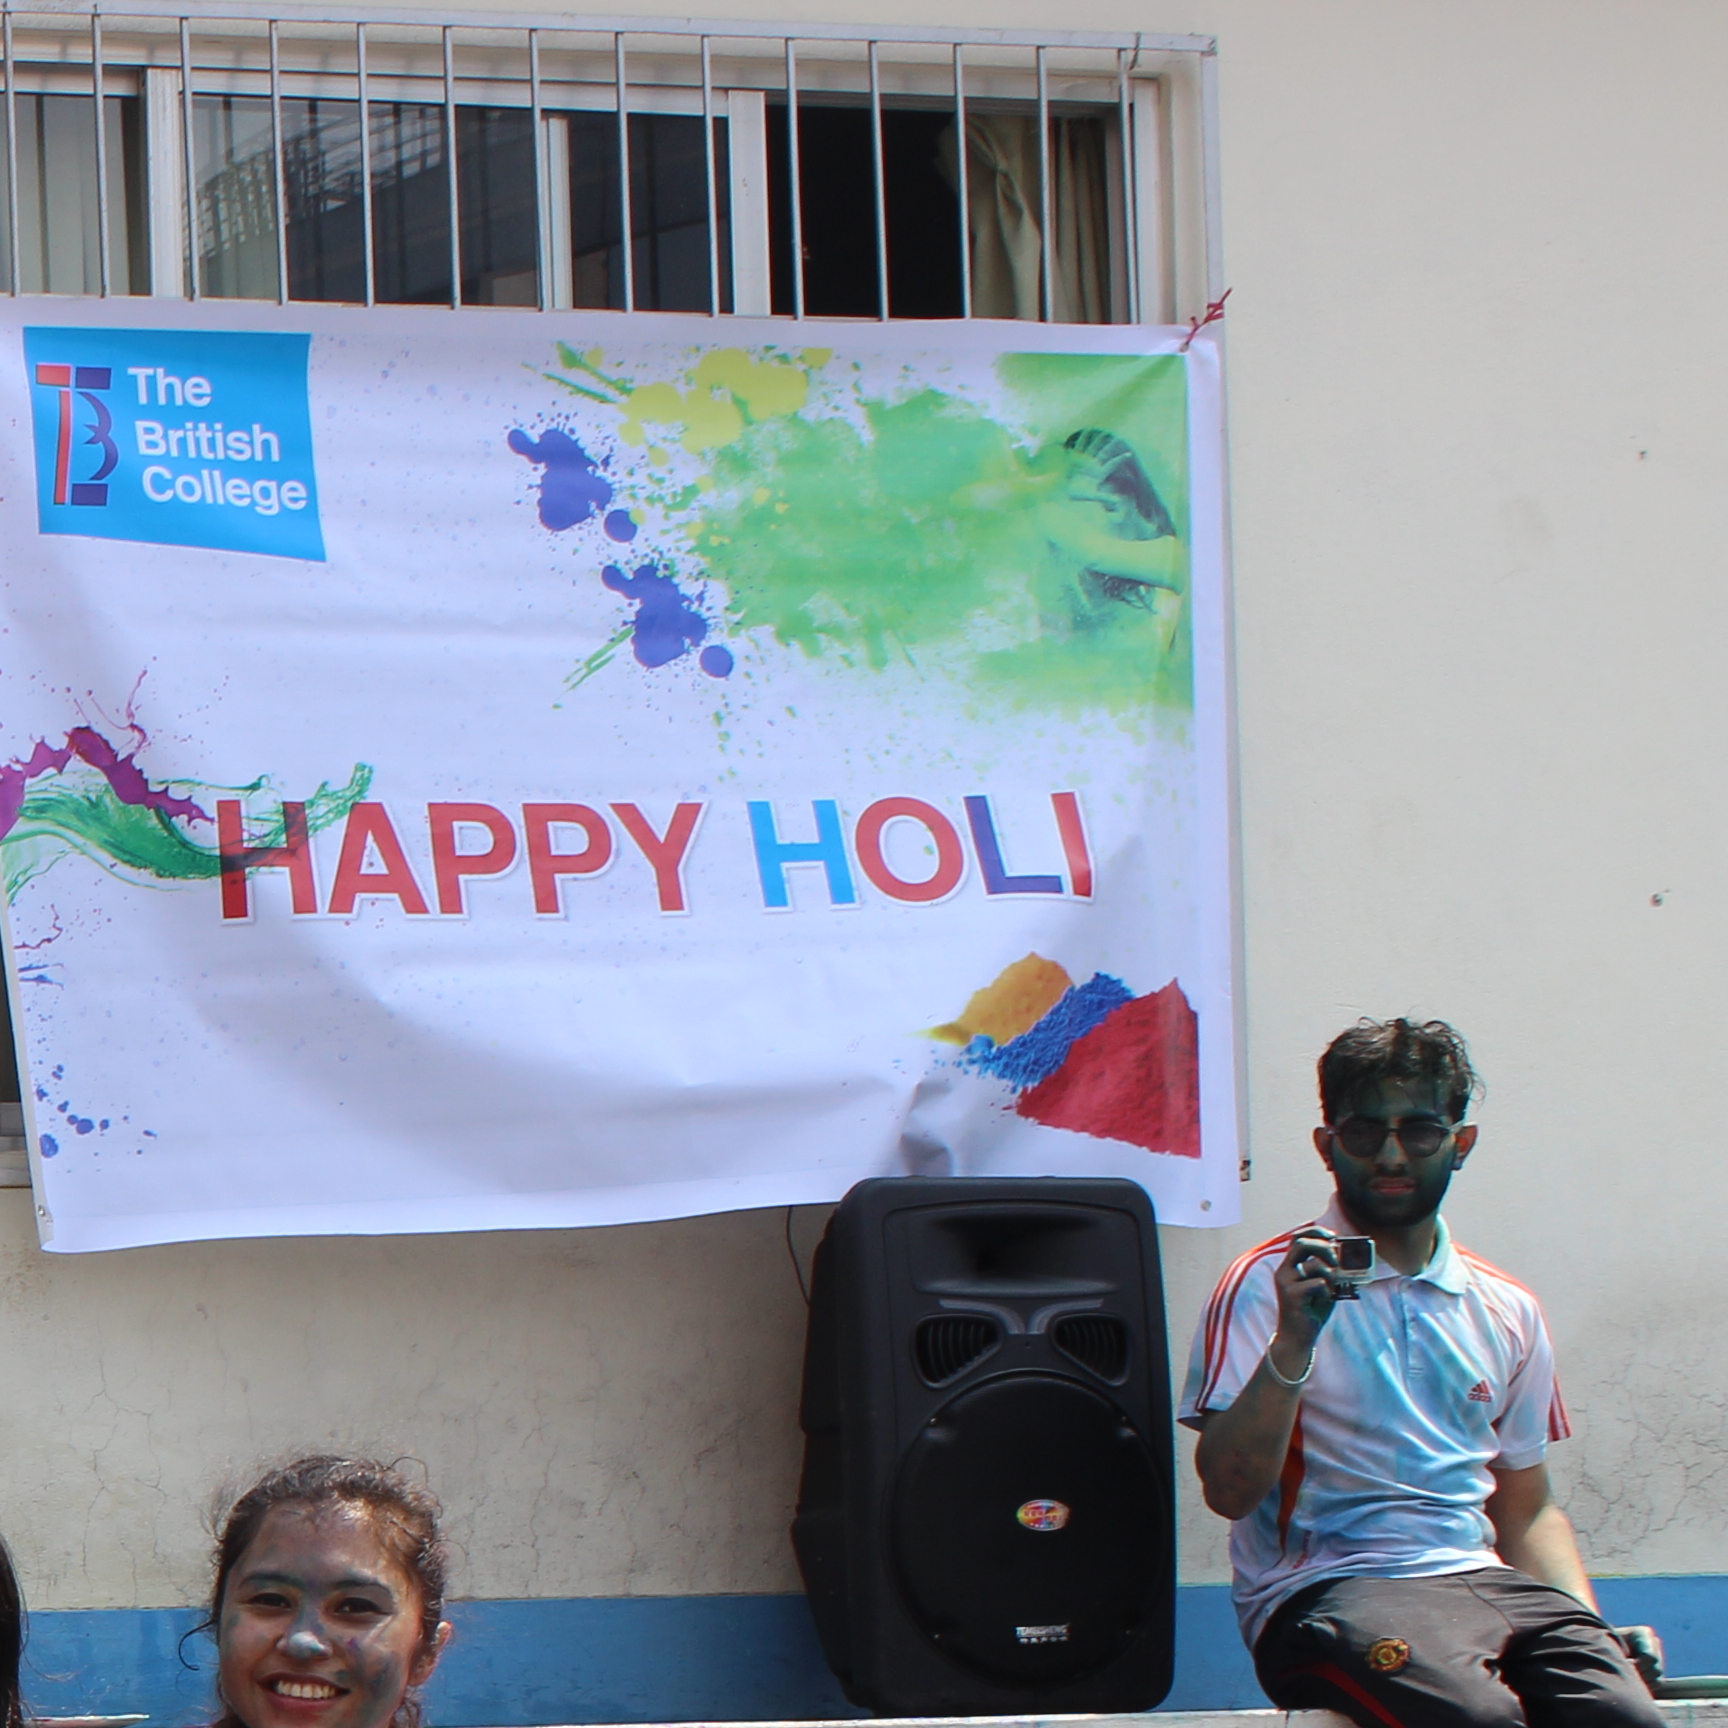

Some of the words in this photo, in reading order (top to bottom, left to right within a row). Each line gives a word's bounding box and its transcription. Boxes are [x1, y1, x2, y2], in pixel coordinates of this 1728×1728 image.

[127, 366, 213, 407] The
[134, 420, 281, 463] British
[141, 465, 308, 517] College
[216, 799, 706, 921] HAPPY
[746, 791, 1093, 910] HOLI
